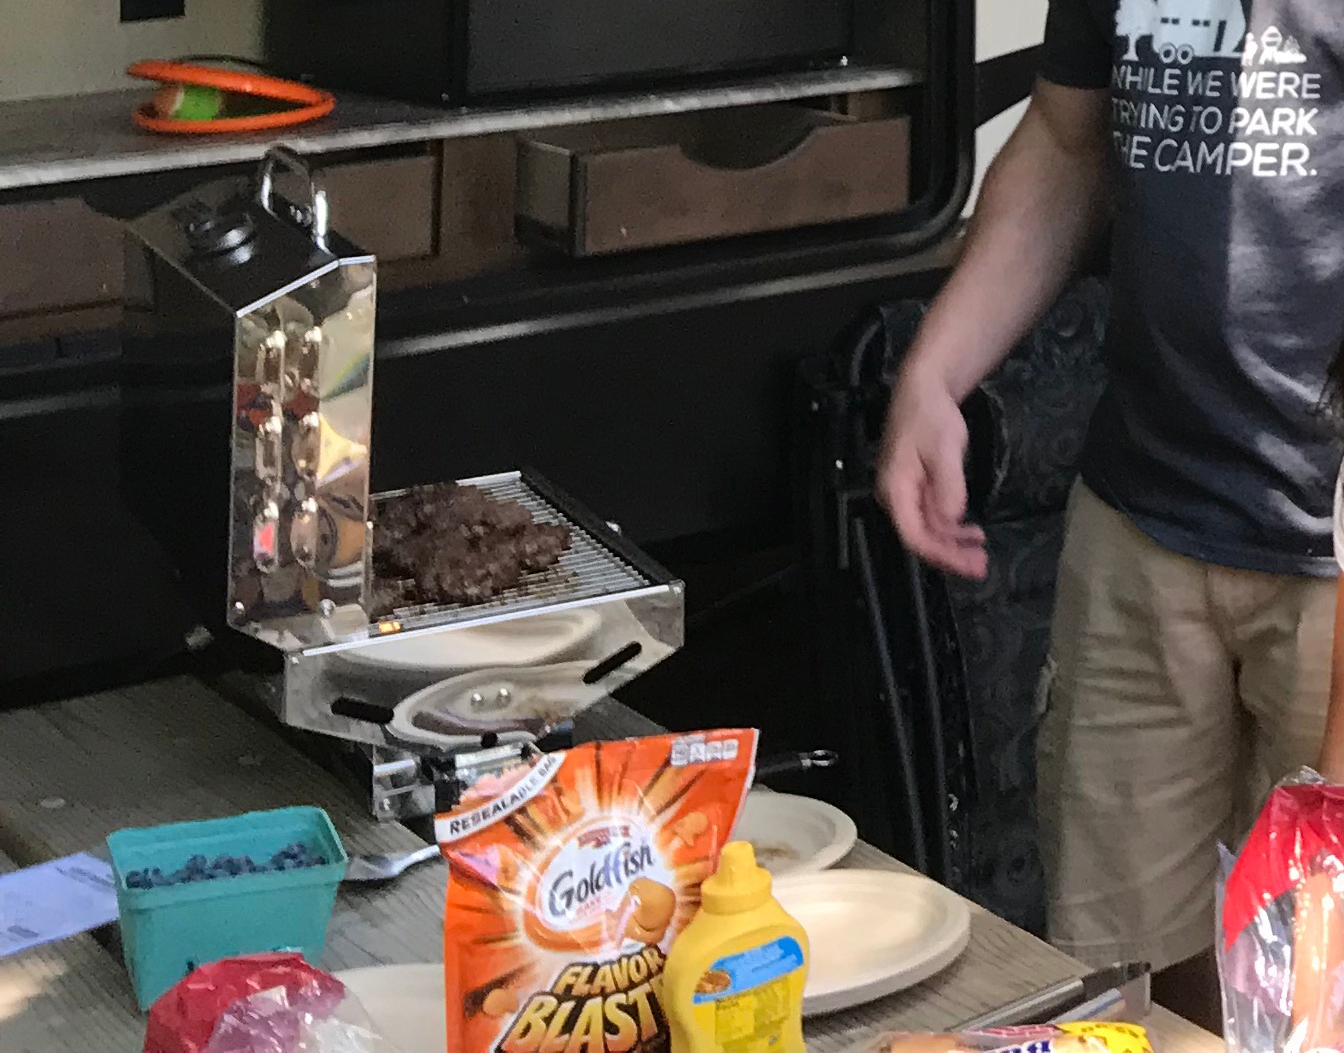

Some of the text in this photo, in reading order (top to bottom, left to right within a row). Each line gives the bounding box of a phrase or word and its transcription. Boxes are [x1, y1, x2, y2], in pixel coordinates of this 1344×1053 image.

[1187, 69, 1224, 97] WE
[1231, 71, 1322, 99] WERE
[1111, 97, 1319, 136] TRYING TO PARK
[1154, 139, 1318, 177] CAMPER.
[548, 840, 655, 918] Goldfish
[552, 948, 665, 996] FLAVOR
